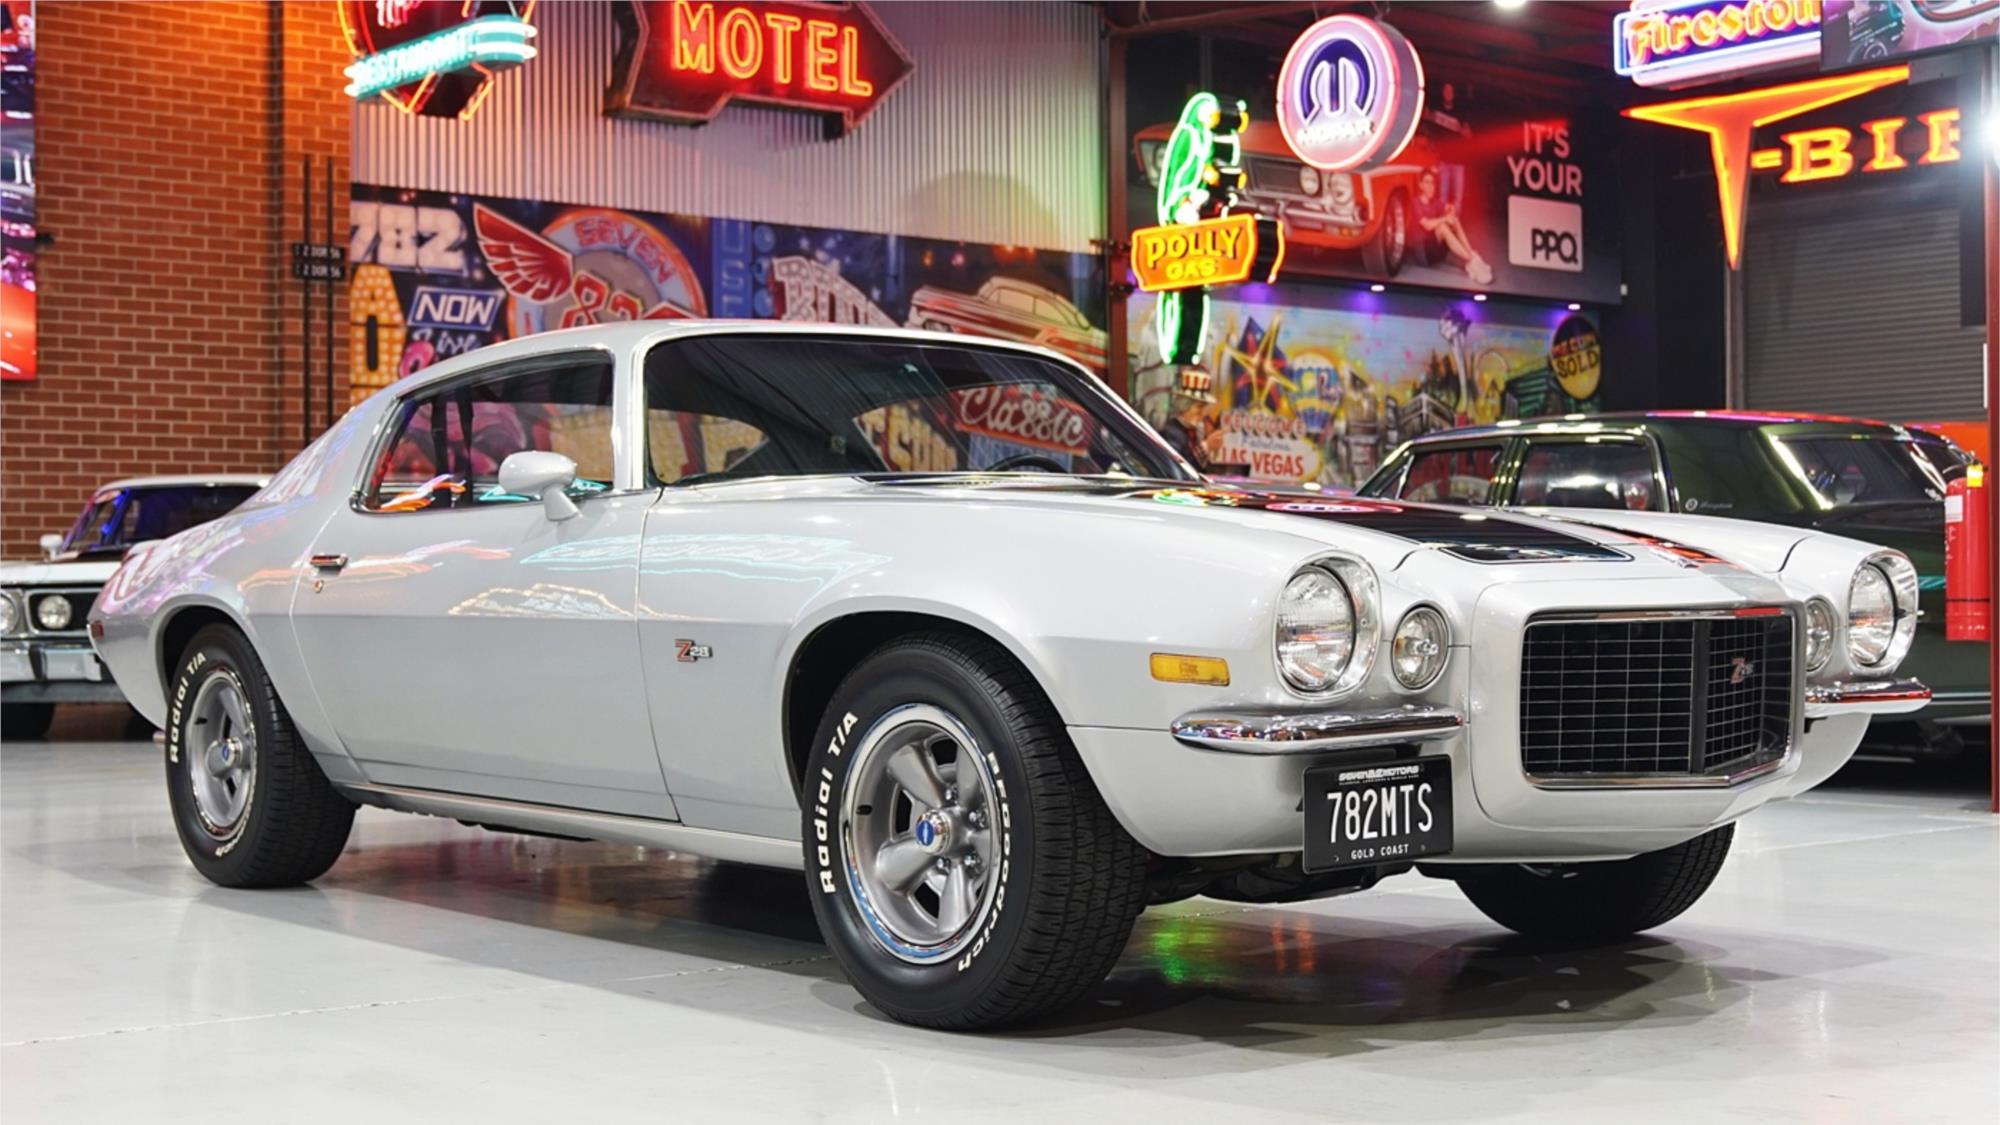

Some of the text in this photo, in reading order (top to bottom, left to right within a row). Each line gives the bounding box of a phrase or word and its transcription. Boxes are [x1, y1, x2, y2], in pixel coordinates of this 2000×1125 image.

[673, 0, 873, 97] MOTEL
[1522, 121, 1571, 159] IT'S
[1507, 156, 1583, 197] YOUR
[350, 200, 467, 275] 782
[575, 217, 678, 285] SEVEN
[1146, 225, 1242, 268] POLLY
[1531, 227, 1579, 265] PPQ
[1165, 257, 1216, 281] GAS
[414, 292, 496, 326] NOW
[1556, 350, 1598, 378] SOLD
[1252, 450, 1305, 477] VEGAS
[674, 638, 711, 662] Z28
[170, 676, 189, 763] Radial
[828, 711, 859, 758] T/A
[815, 767, 836, 894] Radial
[1326, 782, 1433, 844] 782MTS
[1351, 844, 1410, 860] GOLD COAST
